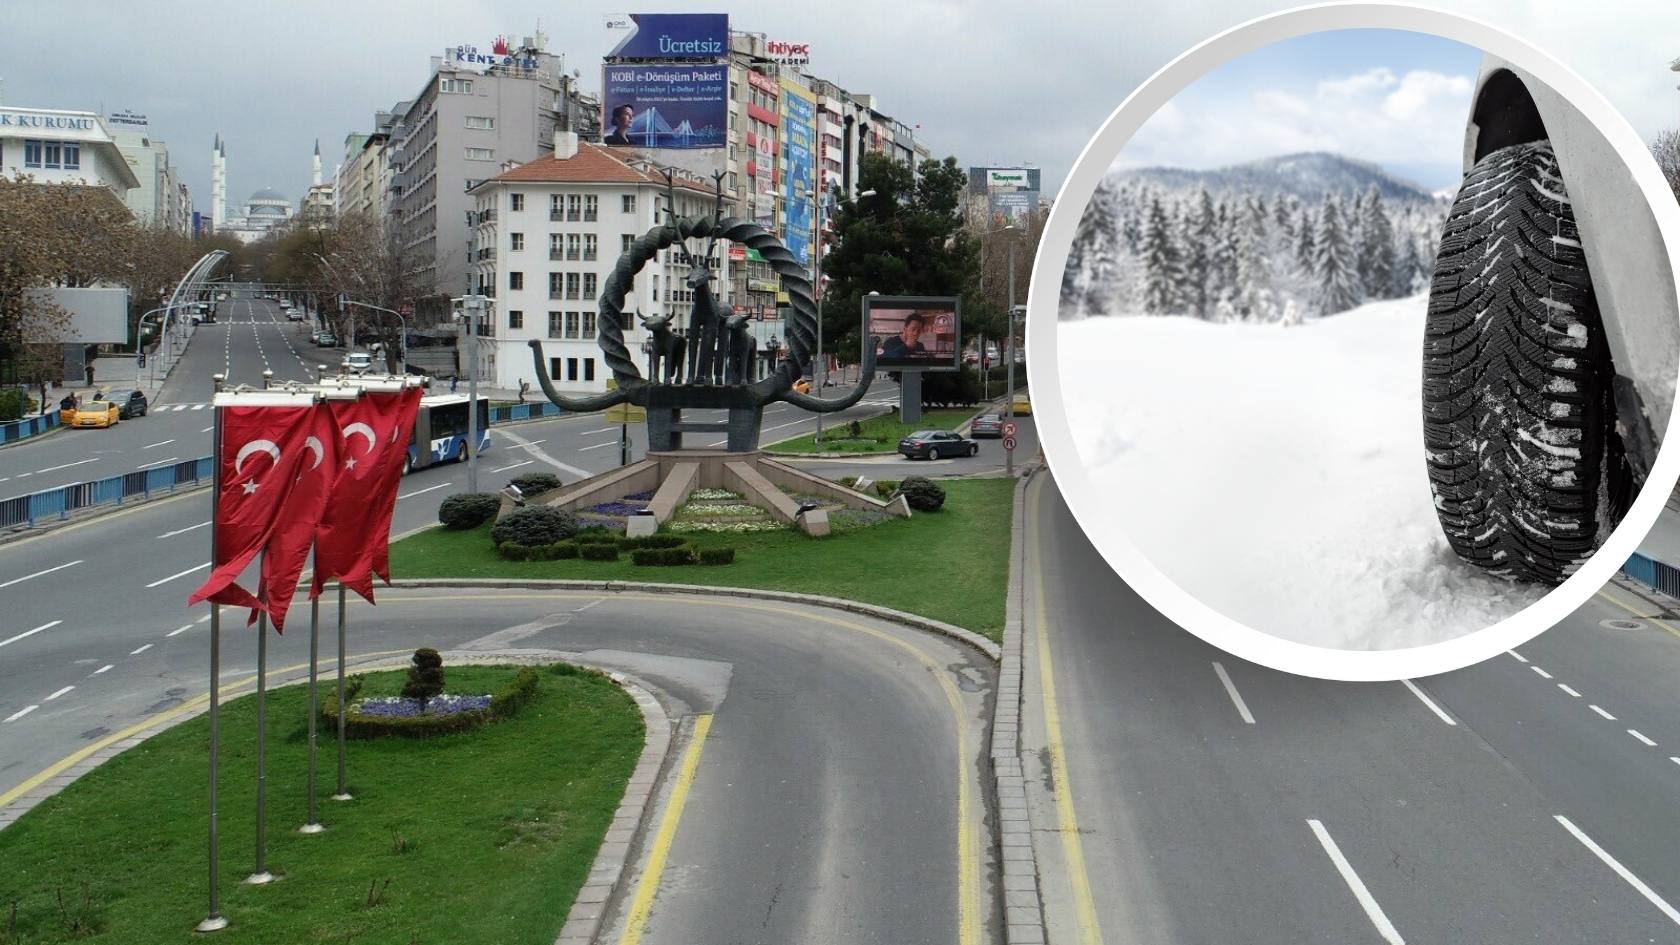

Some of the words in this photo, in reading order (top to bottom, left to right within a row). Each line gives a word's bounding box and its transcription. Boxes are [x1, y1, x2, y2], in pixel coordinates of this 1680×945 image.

[659, 35, 721, 53] Ücretsiz
[767, 41, 809, 57] ihtiyaç
[611, 70, 635, 82] KOBİ
[637, 71, 690, 84] e-Dönüşüm
[692, 71, 722, 81] Paketi
[19, 116, 95, 130] KURUMU
